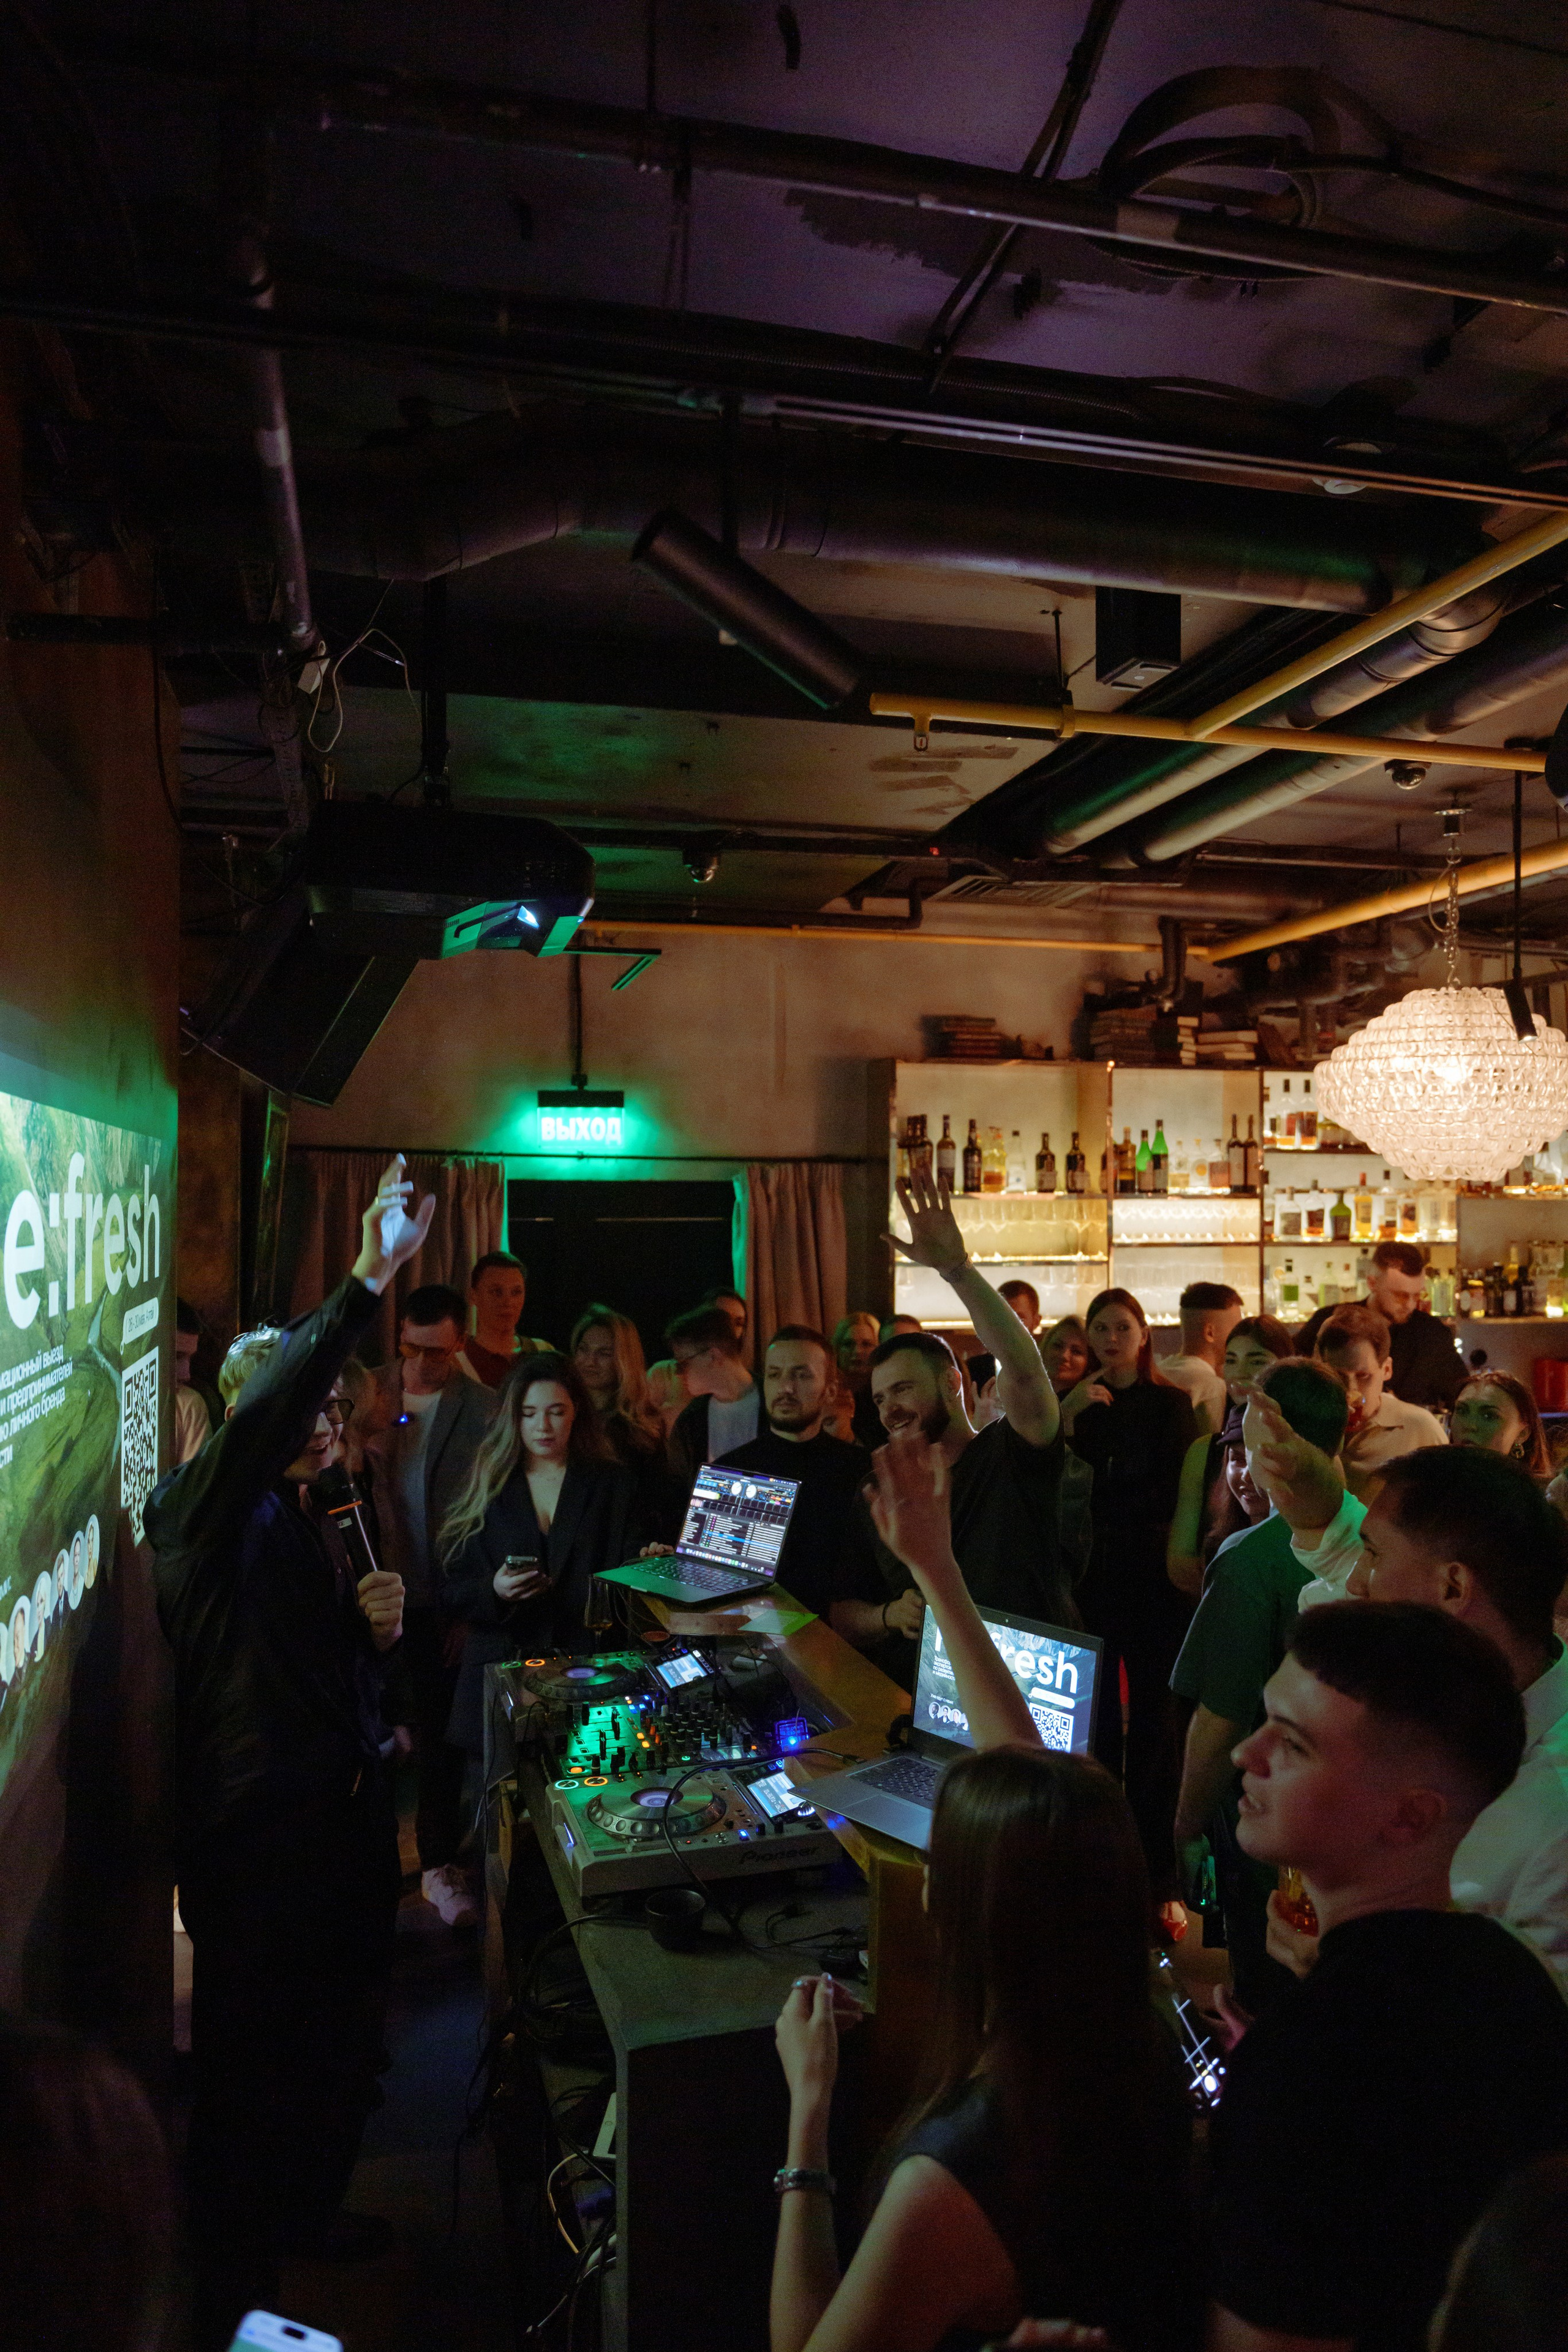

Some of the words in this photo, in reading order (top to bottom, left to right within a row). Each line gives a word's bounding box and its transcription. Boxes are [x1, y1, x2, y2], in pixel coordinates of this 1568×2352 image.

[541, 1117, 622, 1145] ВЫХОД
[43, 1344, 64, 1368] выезд
[7, 1356, 73, 1415] предпринимателей
[9, 1402, 40, 1437] личного
[41, 1386, 66, 1417] бренда
